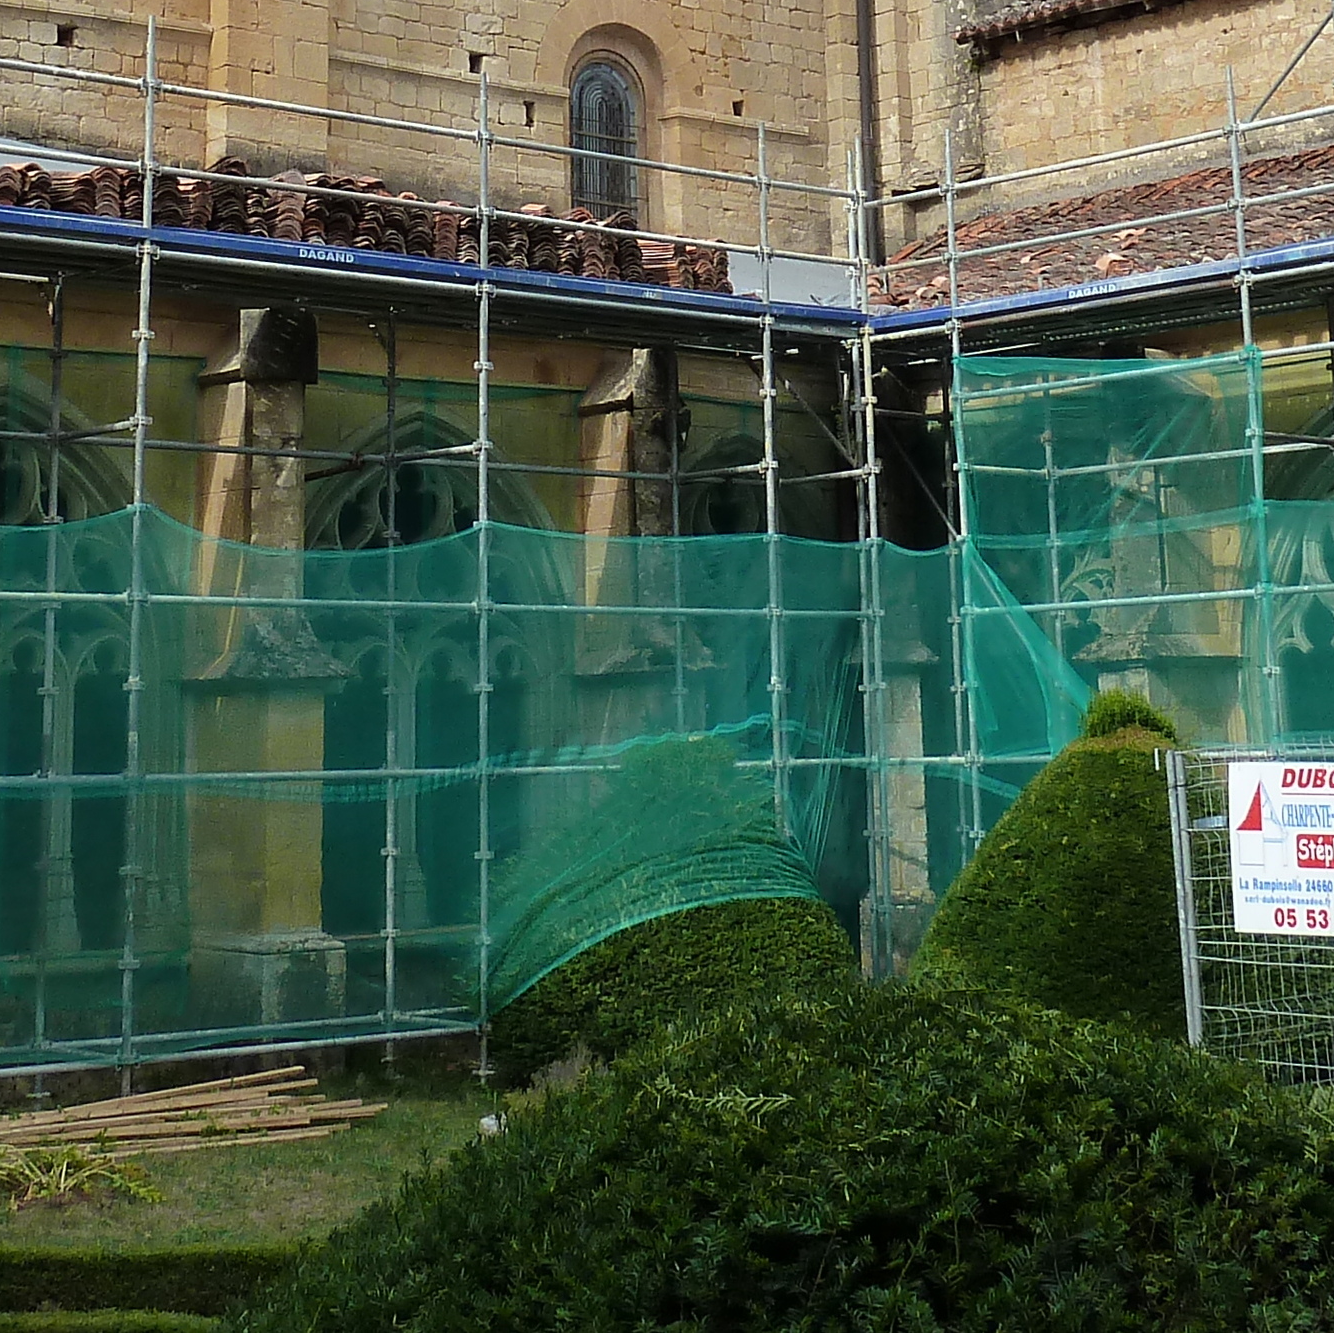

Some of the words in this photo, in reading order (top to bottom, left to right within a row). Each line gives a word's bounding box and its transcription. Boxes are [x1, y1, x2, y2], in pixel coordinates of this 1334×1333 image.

[298, 248, 356, 264] DAGAND
[1067, 283, 1117, 299] DAGAND
[1239, 876, 1249, 890] La
[1306, 878, 1334, 893] 24660
[1274, 907, 1298, 928] 05
[1306, 908, 1330, 929] 53
